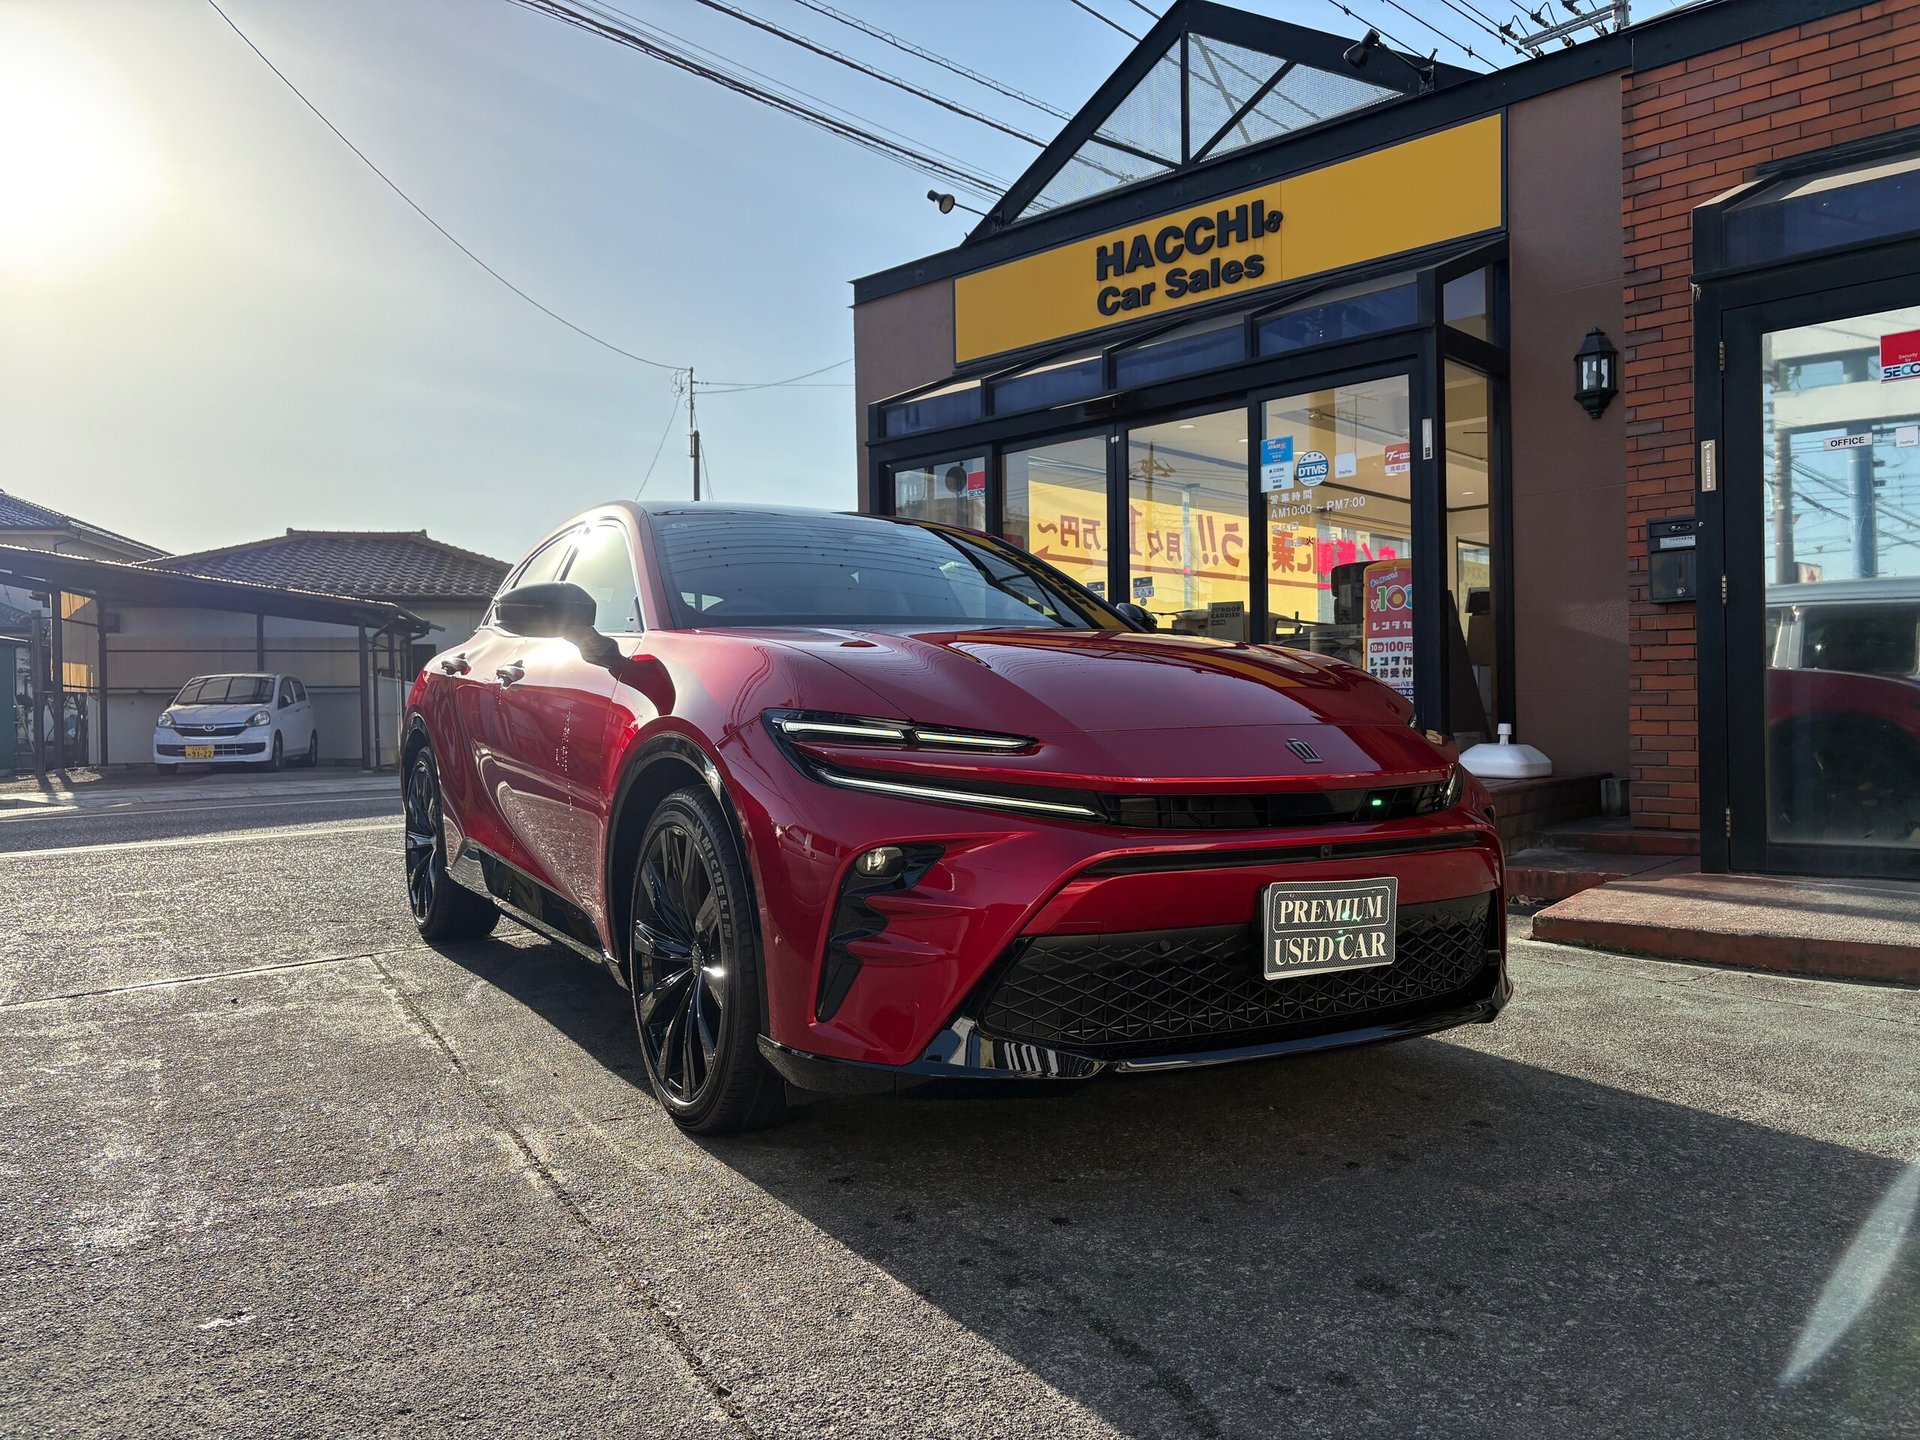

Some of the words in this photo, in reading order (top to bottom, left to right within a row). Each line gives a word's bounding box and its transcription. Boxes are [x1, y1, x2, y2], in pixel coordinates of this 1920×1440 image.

[1097, 282, 1156, 316] Car
[1165, 254, 1265, 299] Sales
[1830, 436, 1865, 448] OFFICE
[1298, 464, 1327, 477] DTMS
[1270, 489, 1312, 505] 営業時間
[1271, 504, 1312, 519] AM10:00
[1326, 496, 1366, 511] PM7:00
[702, 834, 733, 939] MICHELIN
[1278, 895, 1383, 925] PREMIUM
[1274, 936, 1335, 966] USED
[1338, 931, 1387, 961] CAR
